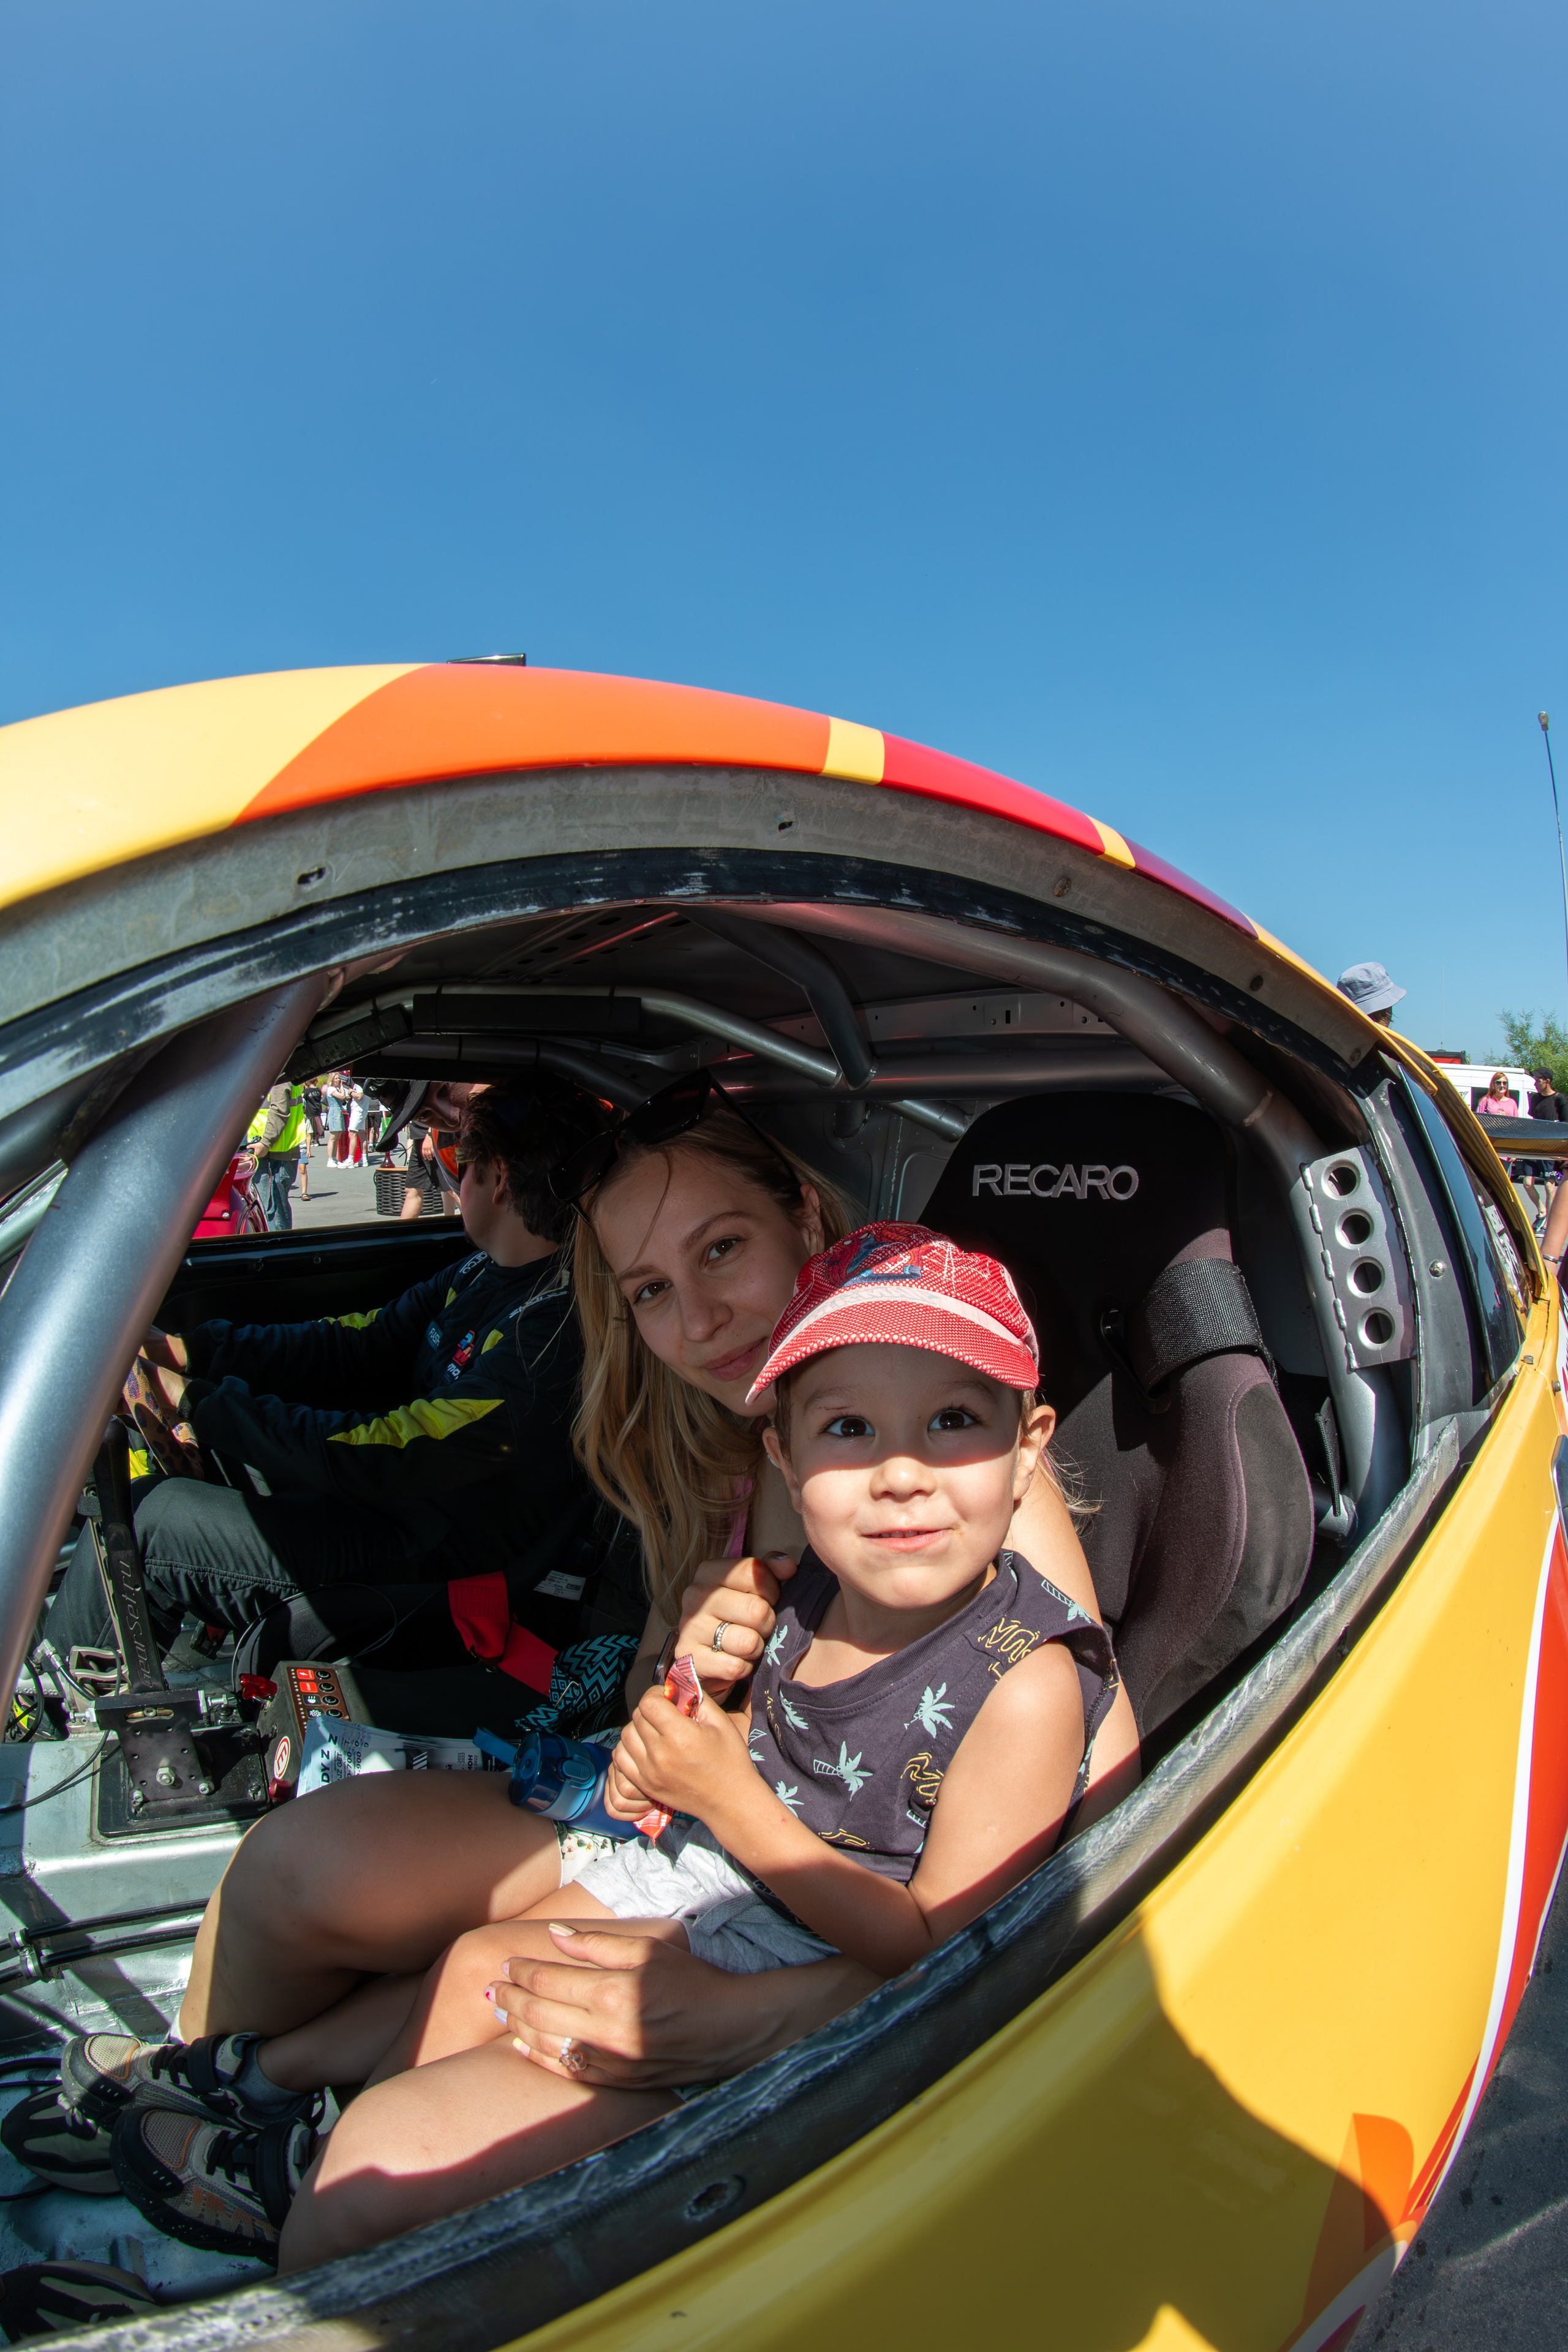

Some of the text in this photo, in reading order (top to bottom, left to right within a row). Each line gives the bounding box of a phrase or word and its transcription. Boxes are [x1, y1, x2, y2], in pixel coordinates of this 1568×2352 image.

[972, 1164, 1139, 1200] RECARO
[459, 1251, 488, 1274] arco
[321, 1749, 330, 1760] Z
